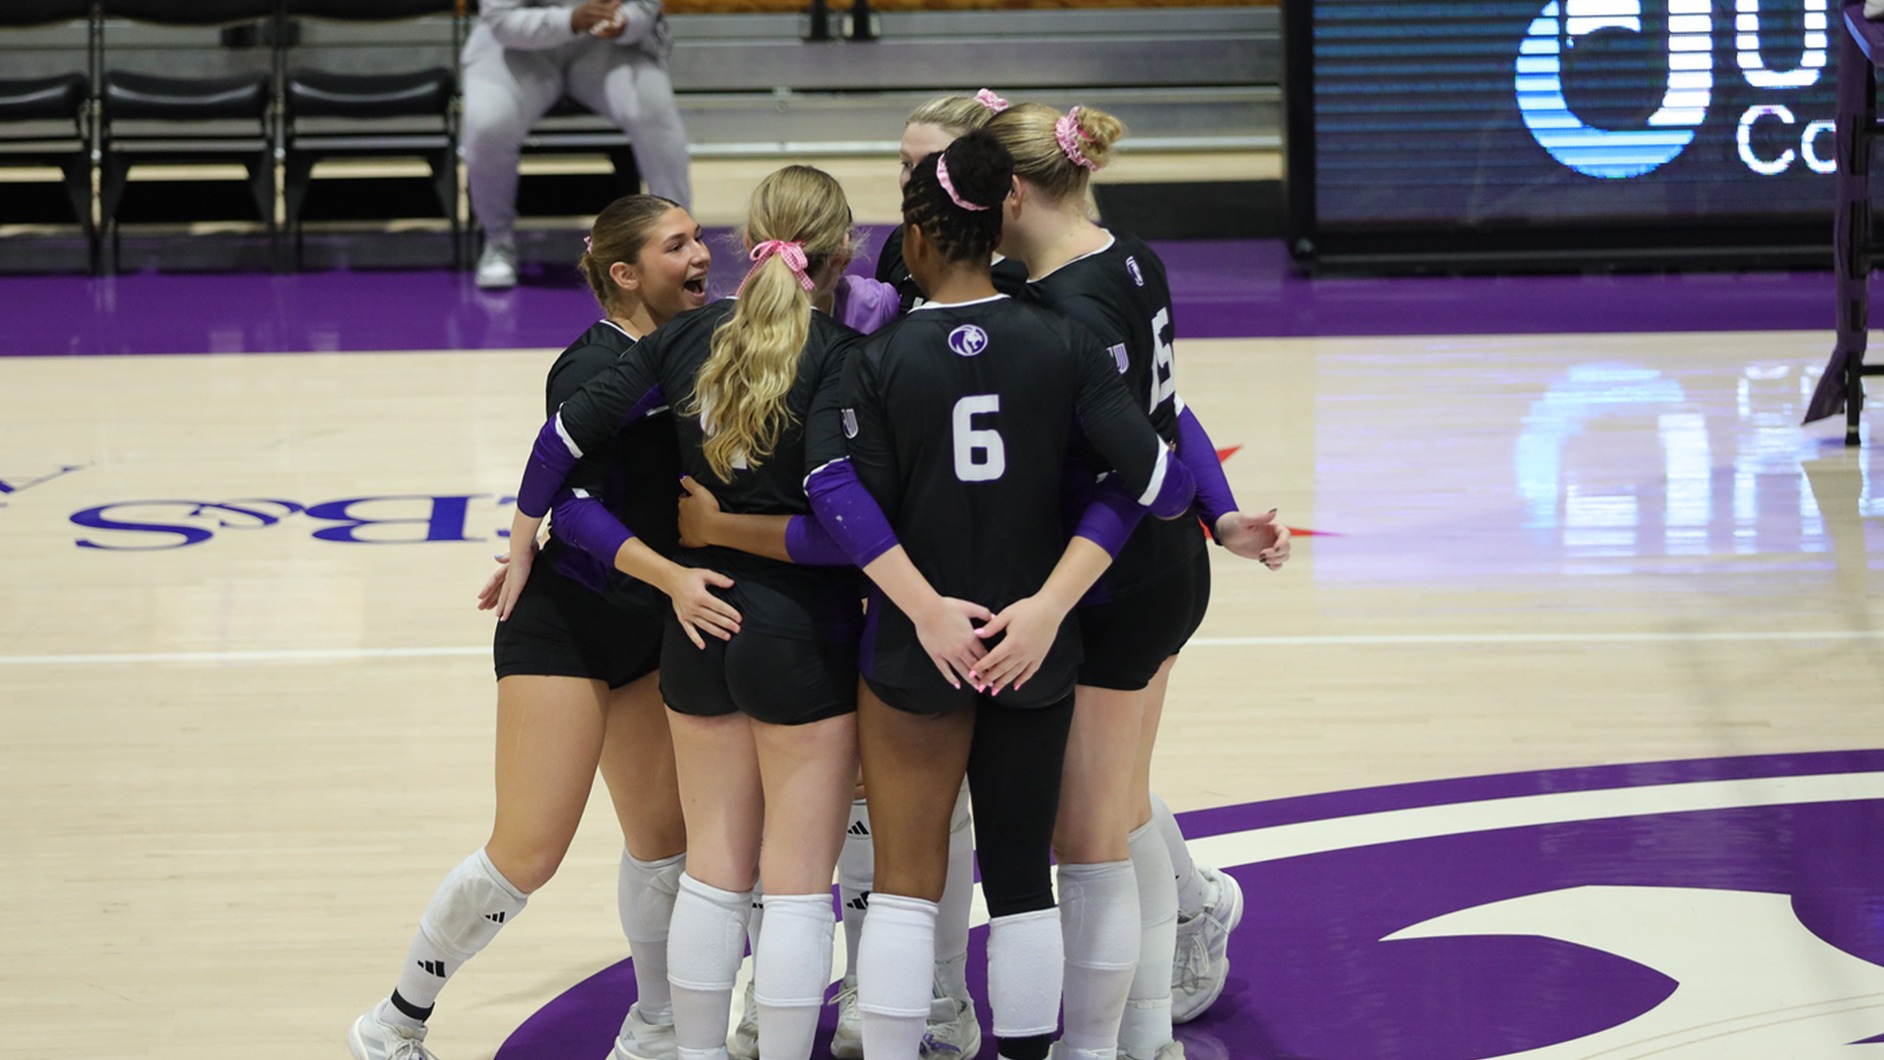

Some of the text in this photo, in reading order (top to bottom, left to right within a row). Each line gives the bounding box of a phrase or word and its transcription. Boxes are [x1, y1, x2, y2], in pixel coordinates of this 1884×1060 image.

[1738, 104, 1837, 176] Co
[952, 394, 1006, 482] 6
[69, 493, 517, 551] B&S
